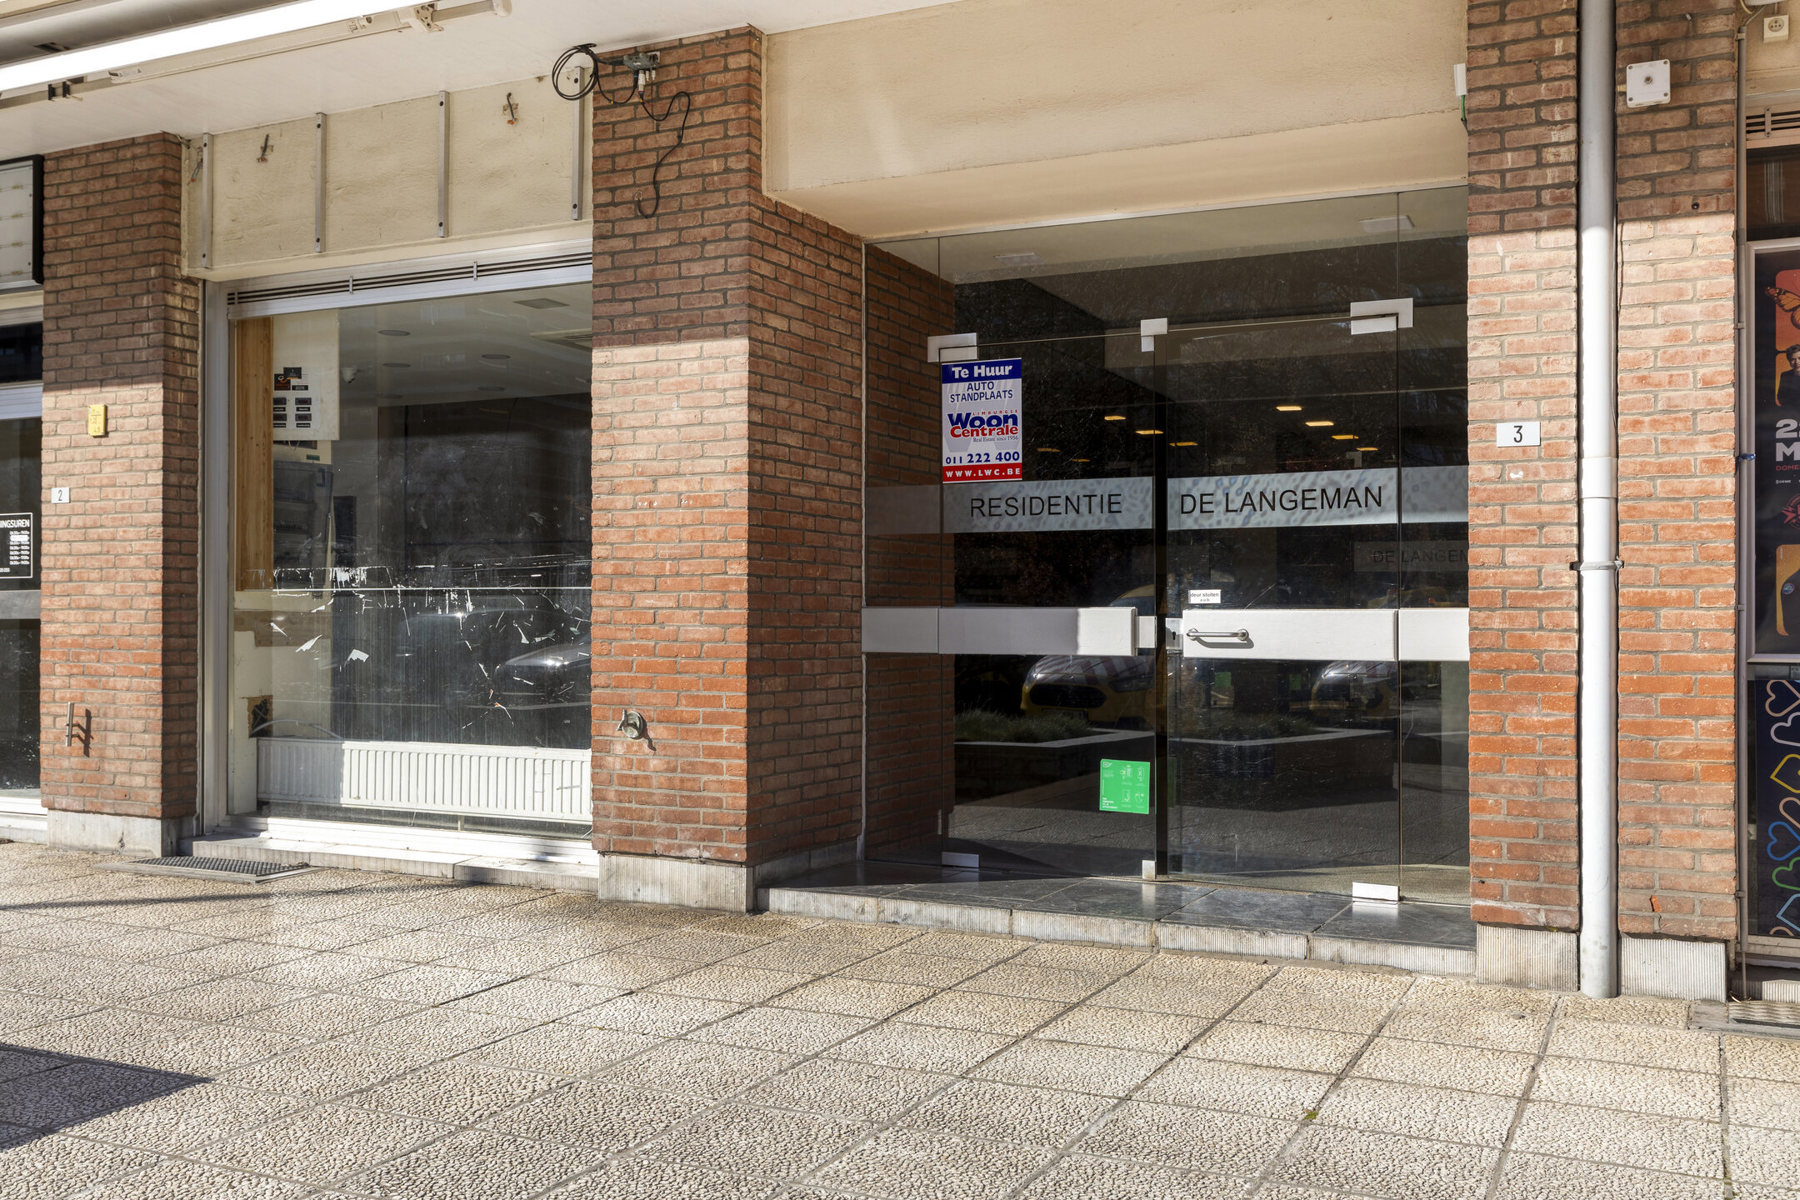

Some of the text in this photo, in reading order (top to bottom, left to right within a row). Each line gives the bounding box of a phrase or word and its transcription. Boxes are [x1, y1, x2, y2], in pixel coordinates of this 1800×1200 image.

[952, 365, 1013, 379] Te Huur
[966, 381, 995, 392] AUTO
[950, 389, 1013, 403] STANDPLAATS
[947, 412, 1018, 430] Woon
[950, 424, 1019, 438] Centrale
[1513, 425, 1523, 443] 3
[945, 451, 1020, 465] 011 222 400
[945, 467, 1021, 478] WWW.LWC.BE
[57, 489, 63, 502] 2
[970, 486, 1383, 518] RESIDENTIE DE LANGEMAN
